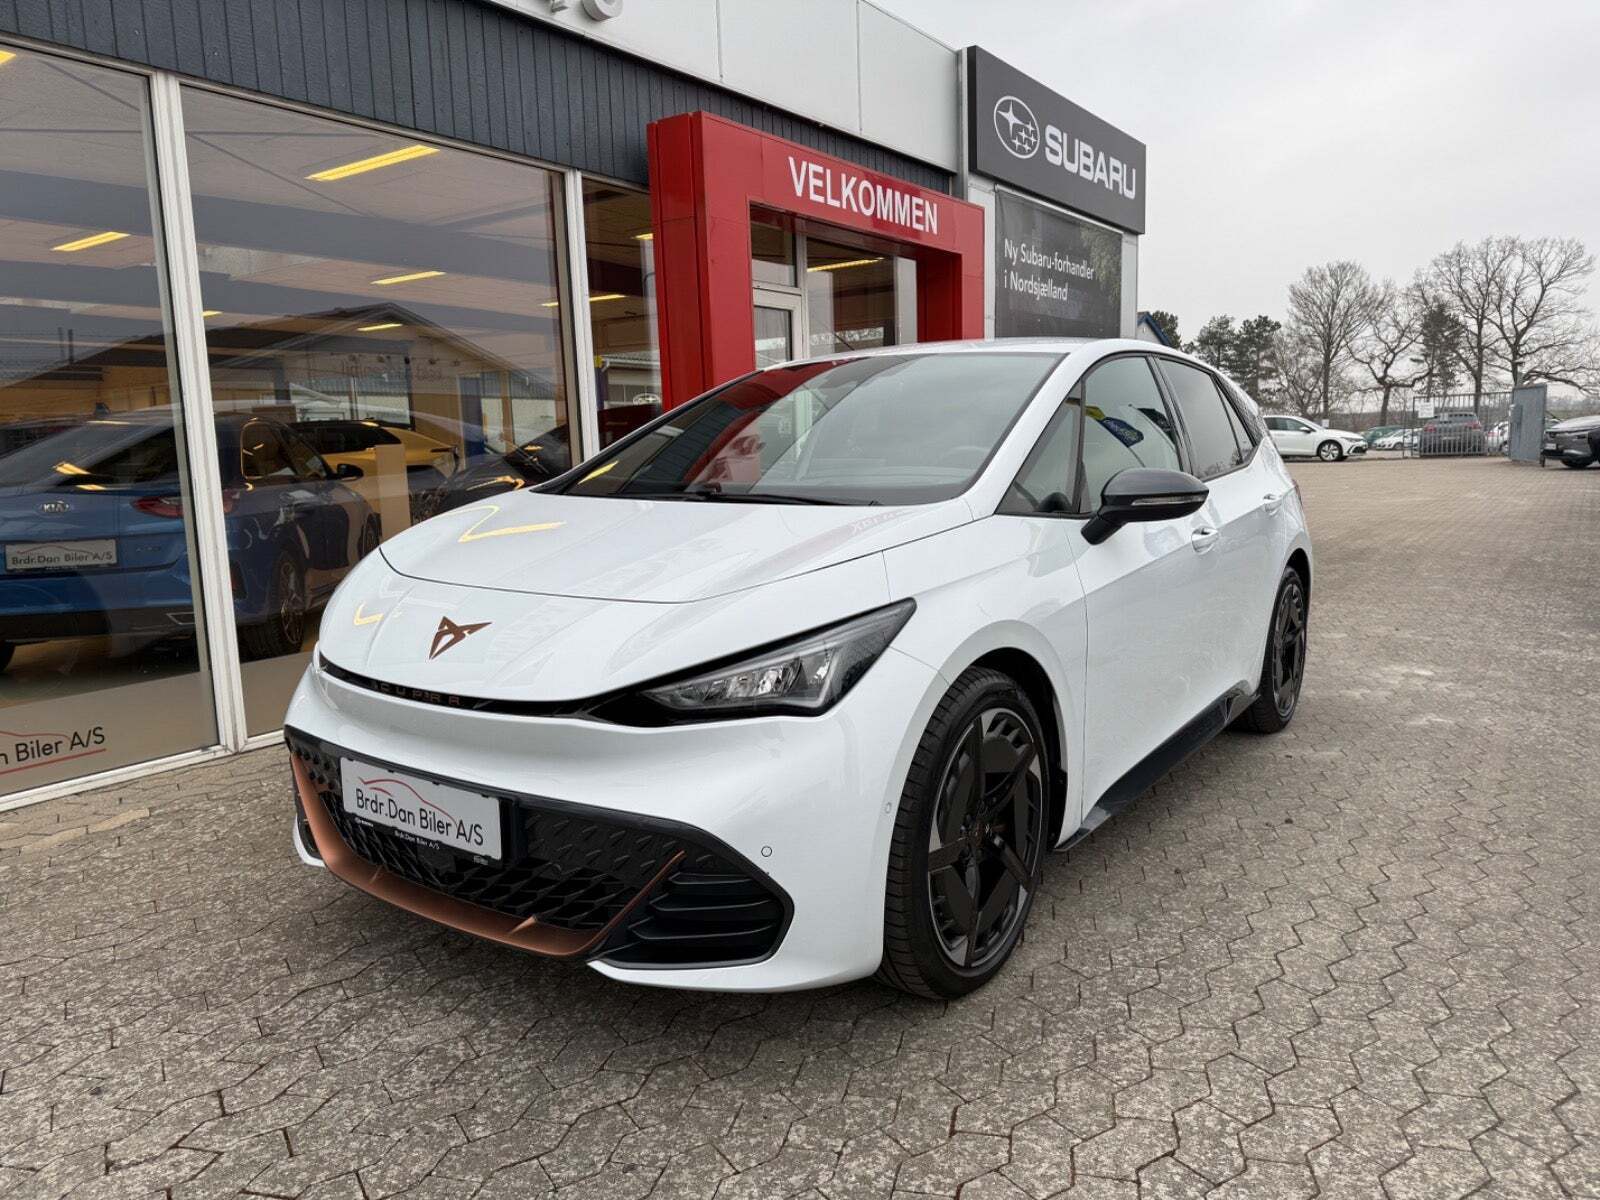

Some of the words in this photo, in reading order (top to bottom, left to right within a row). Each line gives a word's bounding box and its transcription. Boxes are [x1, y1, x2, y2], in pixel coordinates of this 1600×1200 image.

[1044, 124, 1136, 200] SUBARU
[788, 156, 938, 235] VELKOMMEN
[1004, 238, 1018, 266] Ny
[1020, 243, 1094, 280] Subaru-forhandler
[1010, 270, 1068, 301] Nordsjælland
[11, 555, 60, 566] Brdr.Dan
[64, 553, 89, 562] Biler
[92, 551, 113, 561] A/S
[15, 739, 63, 762] Biler
[70, 726, 105, 751] A/S
[355, 787, 416, 826] Brdr.Dan
[419, 807, 452, 837] Biler
[456, 819, 484, 847] A/S
